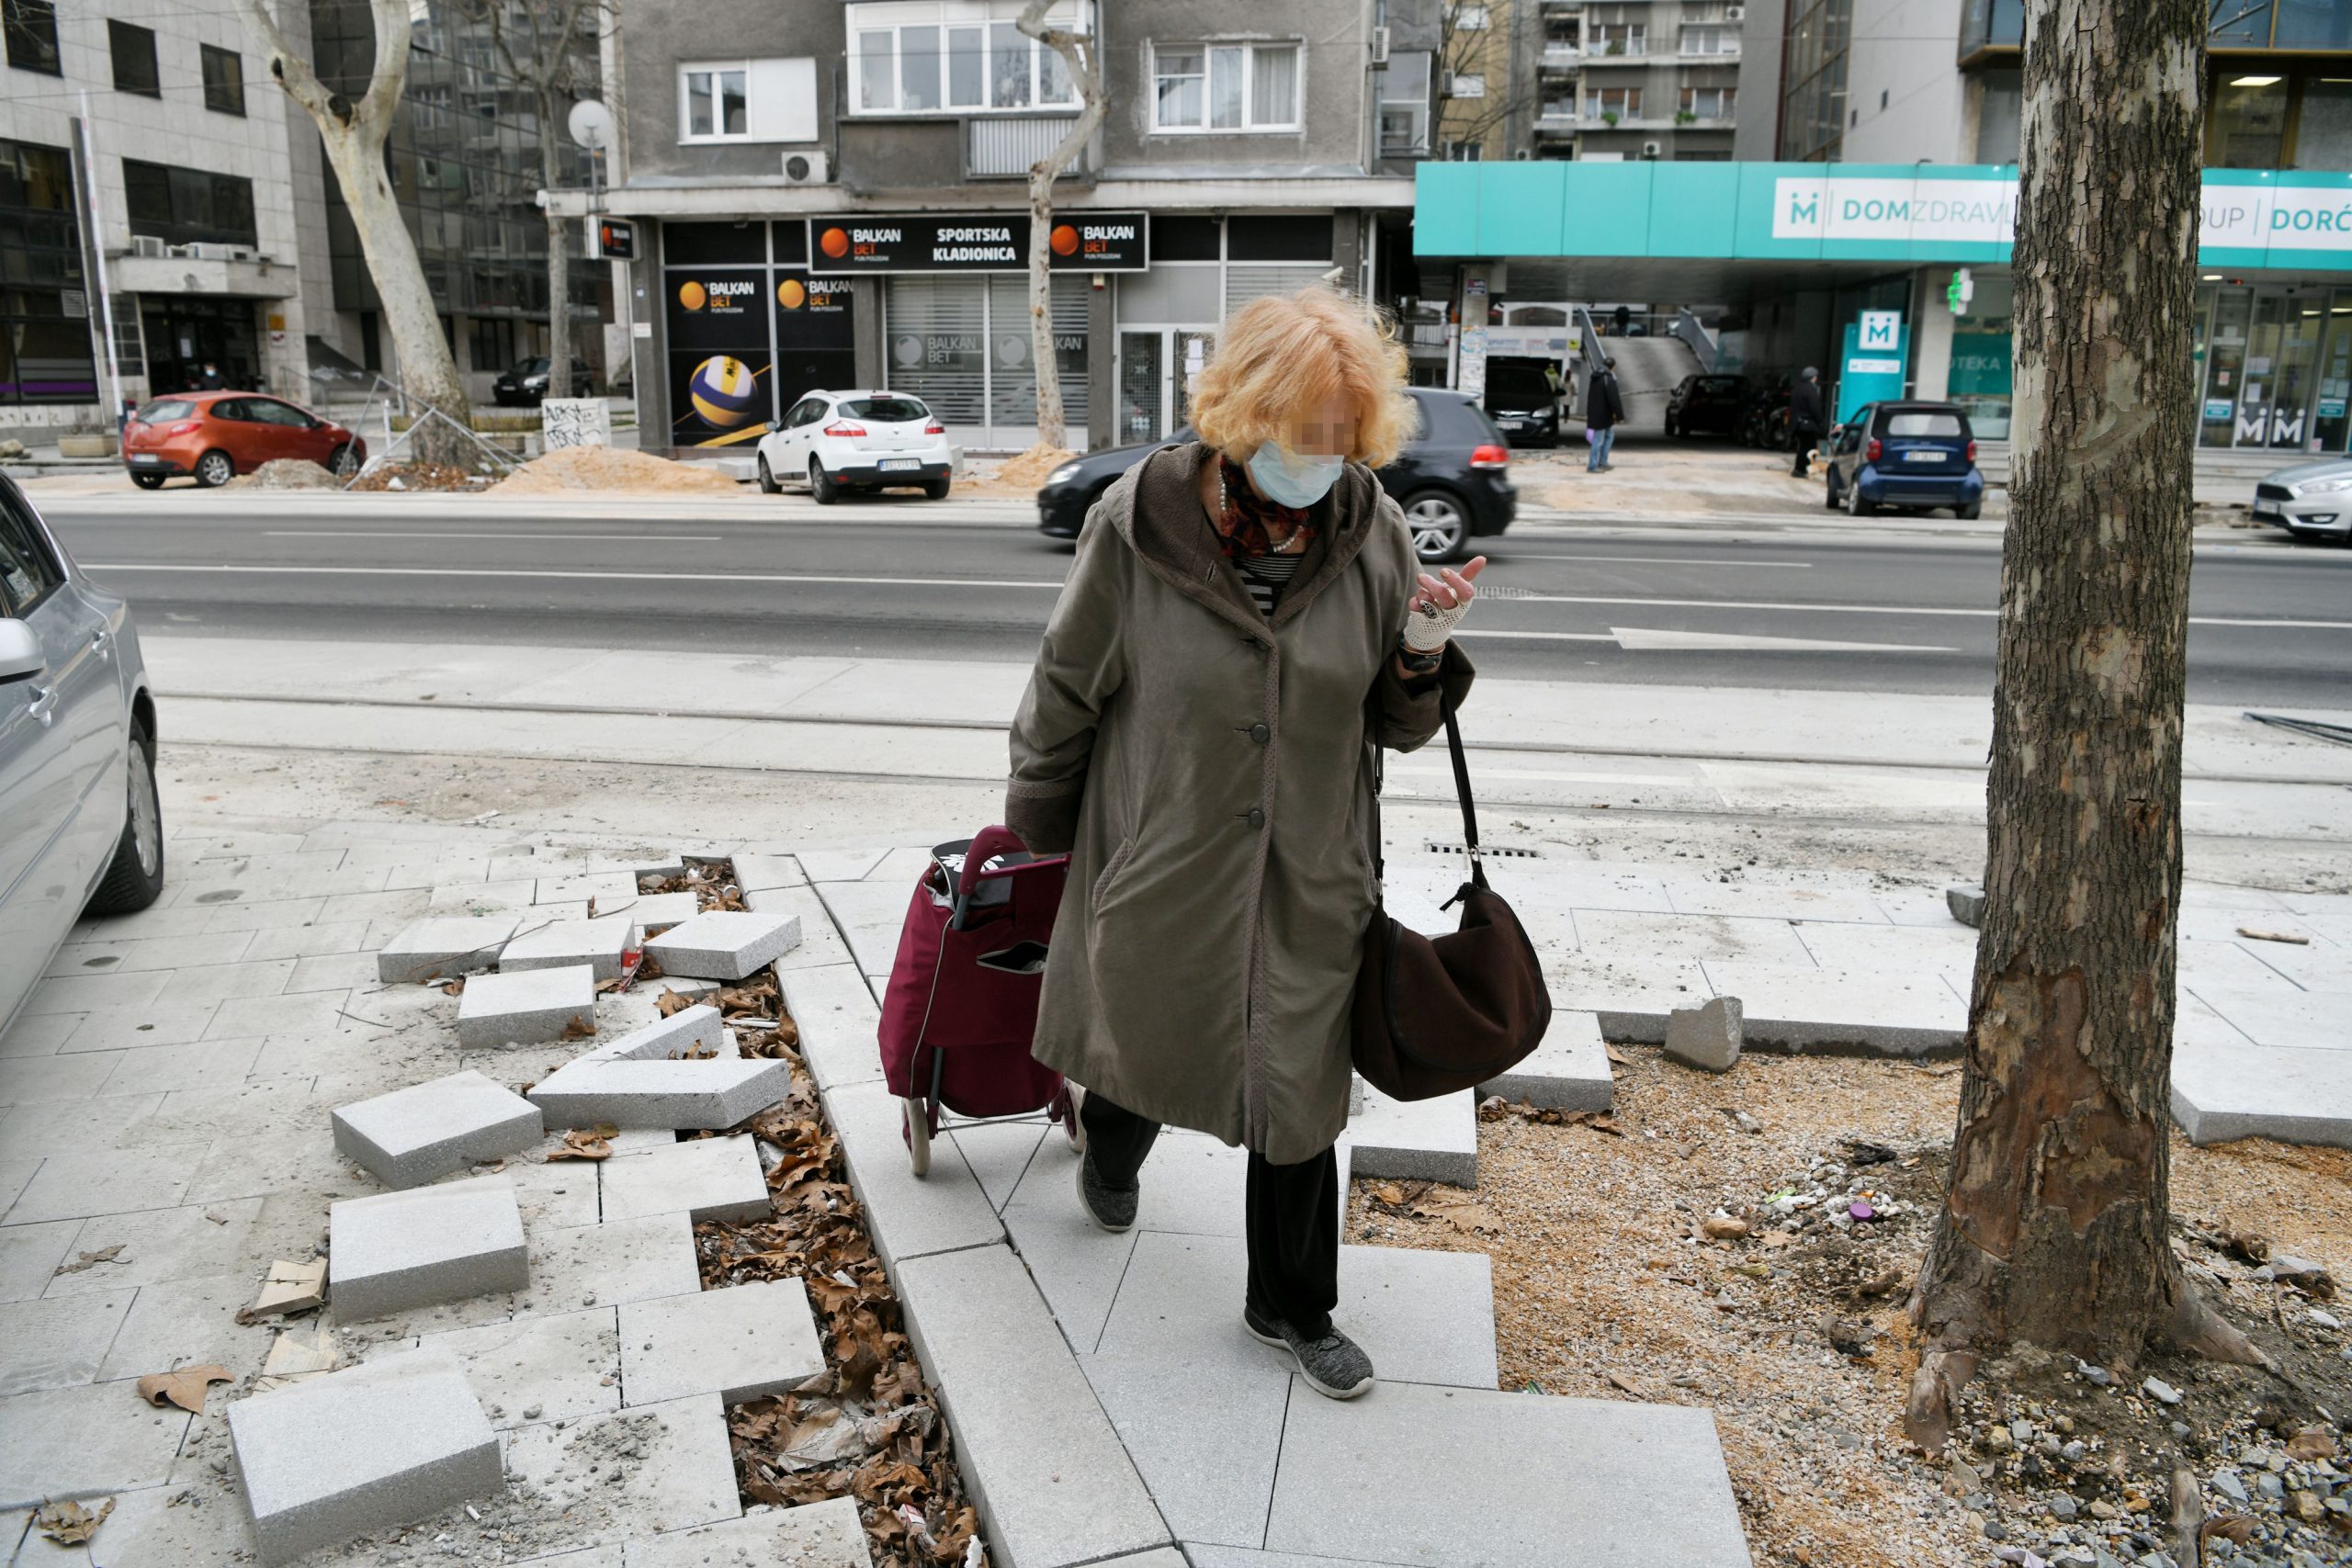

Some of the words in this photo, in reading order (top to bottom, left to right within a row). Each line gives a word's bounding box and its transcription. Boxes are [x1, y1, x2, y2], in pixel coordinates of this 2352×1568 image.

[1843, 199, 2013, 224] DOMZDRAVL
[853, 229, 901, 243] BALKAN
[936, 227, 1011, 243] SPORTSKA
[1084, 226, 1135, 240] BALKAN
[854, 243, 876, 255] BET
[1084, 240, 1107, 253] BET
[933, 246, 1016, 262] KLADIONICA
[709, 281, 754, 296] BALKAN
[808, 279, 854, 294] BALKAN
[710, 296, 731, 308] BET
[809, 294, 831, 306] BET
[927, 336, 977, 350] BALKAN
[1054, 336, 1082, 350] KAN
[927, 350, 951, 364] BET
[1950, 355, 2001, 371] TEKA
